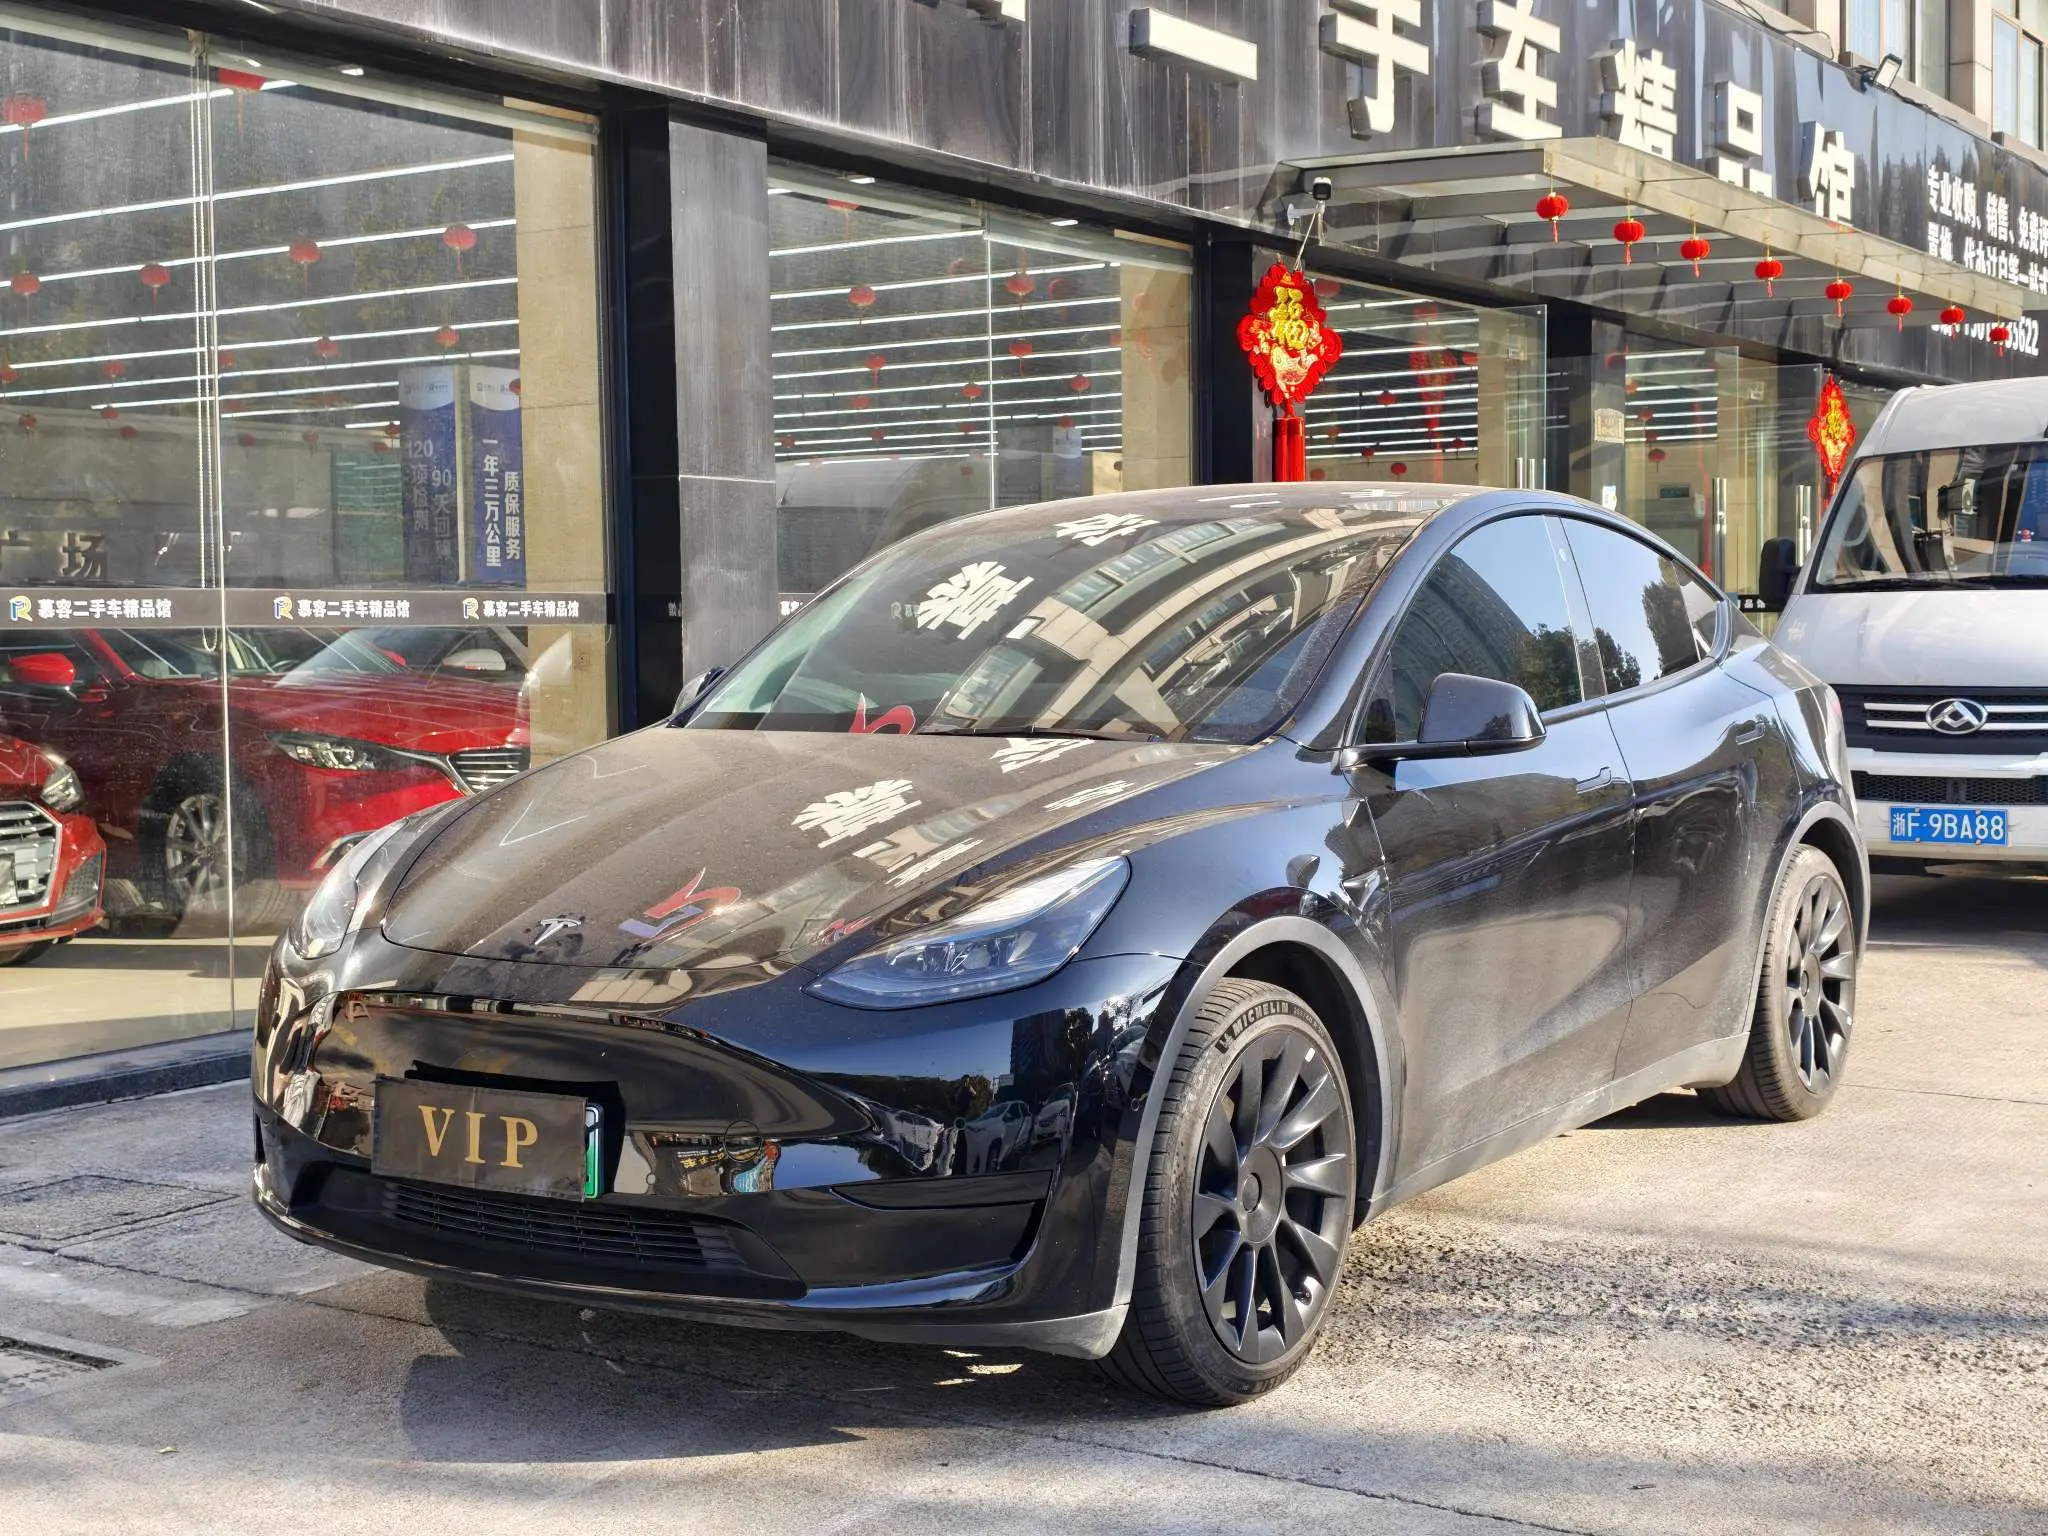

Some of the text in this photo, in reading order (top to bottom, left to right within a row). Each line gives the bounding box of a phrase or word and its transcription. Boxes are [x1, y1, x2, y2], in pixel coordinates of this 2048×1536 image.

[482, 438, 502, 567] 一年三万公里
[504, 471, 520, 560] 质保服务
[1232, 1000, 1290, 1038] MICHELIN
[418, 1104, 539, 1168] VIP
